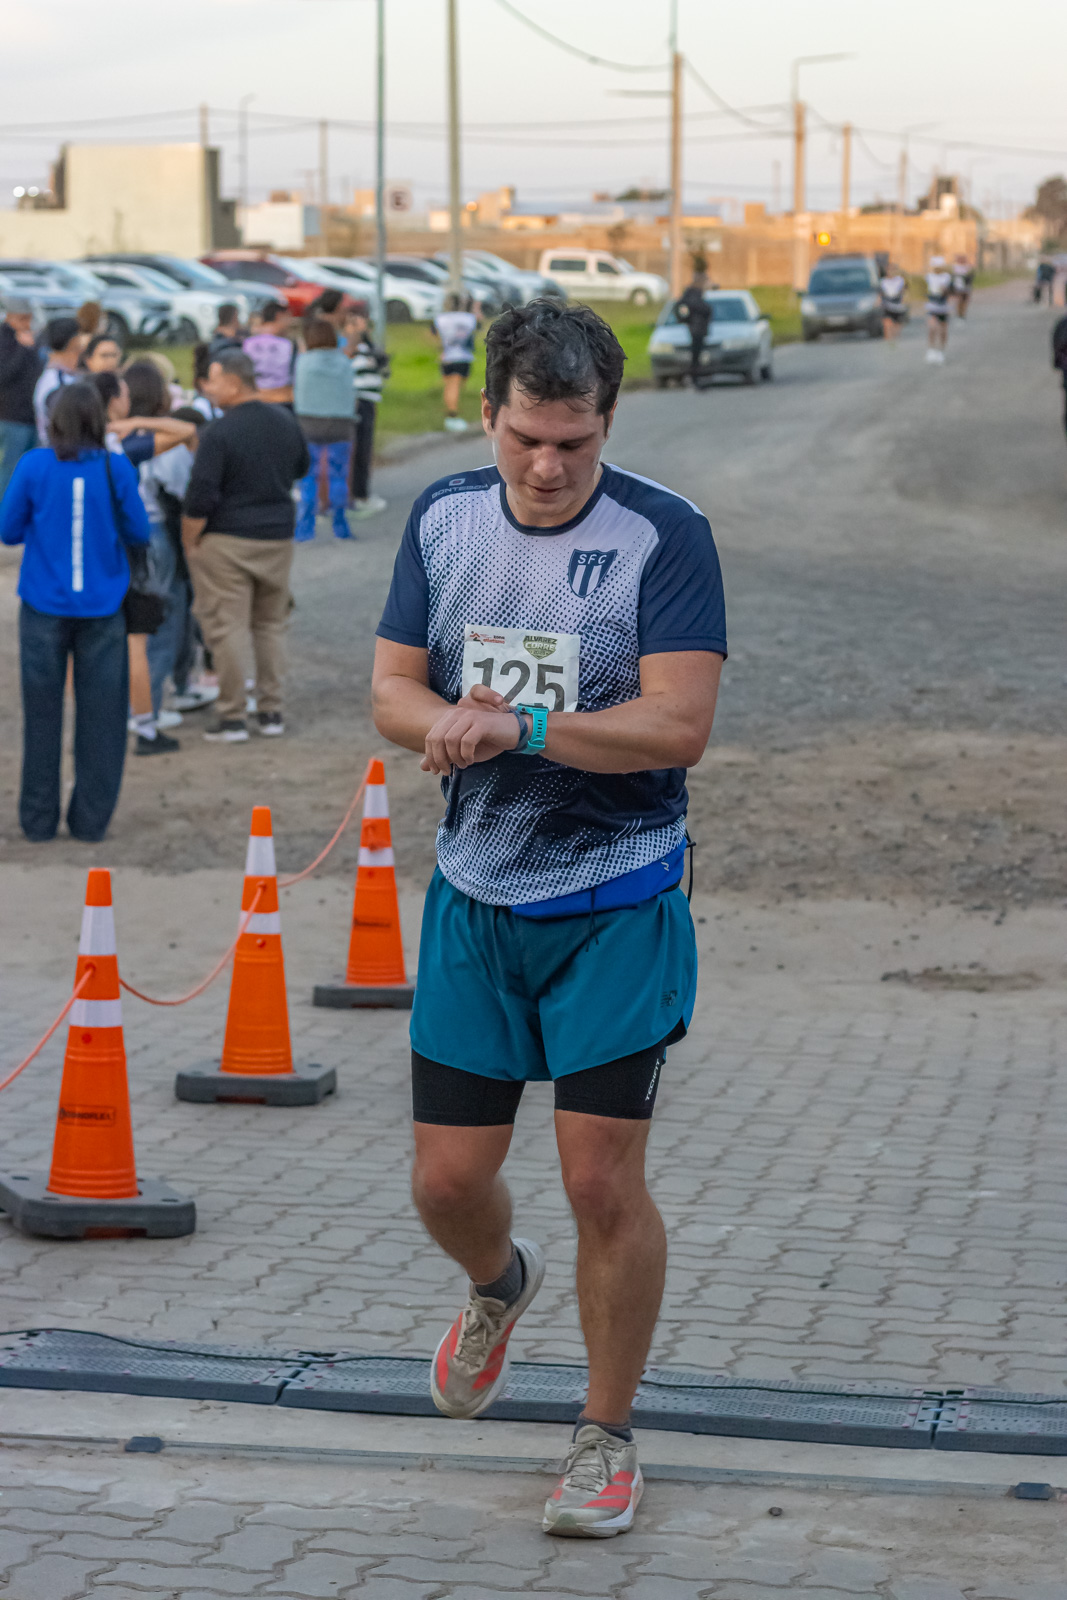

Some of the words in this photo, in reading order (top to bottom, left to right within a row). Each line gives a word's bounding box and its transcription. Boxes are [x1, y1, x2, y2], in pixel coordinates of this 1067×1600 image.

[577, 553, 607, 565] SFC
[524, 635, 558, 645] ALVAREZ
[524, 641, 557, 651] CORRE
[473, 657, 565, 713] 125
[645, 1058, 660, 1101] TECHFIT
